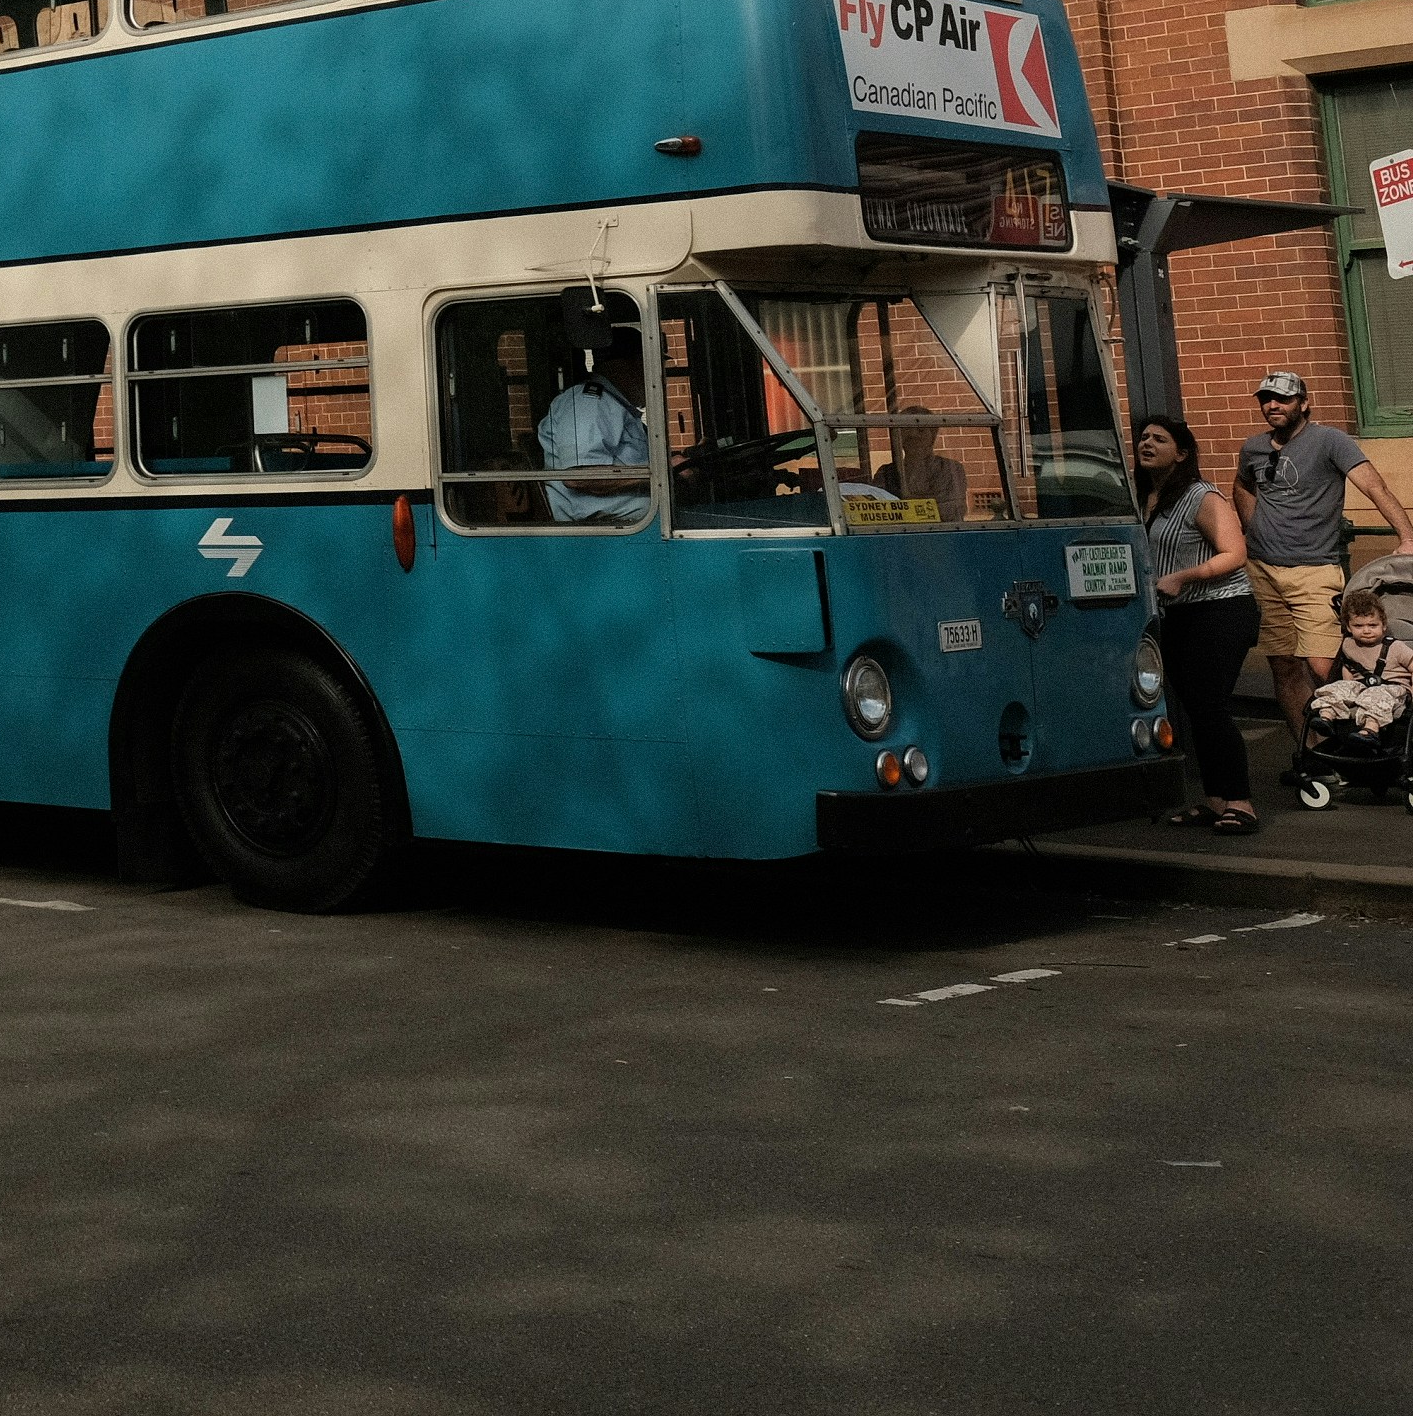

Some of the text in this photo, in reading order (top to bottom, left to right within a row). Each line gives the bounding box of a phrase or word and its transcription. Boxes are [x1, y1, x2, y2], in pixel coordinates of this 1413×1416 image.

[939, 3, 980, 51] Air
[853, 75, 997, 120] Canadian Pacific
[1379, 163, 1411, 186] BUS
[849, 501, 909, 511] SYDNEY BUS
[860, 512, 903, 521] MUSEUM
[1083, 562, 1128, 576] RAILWAY RAMP
[1084, 579, 1107, 592] COUNTRY
